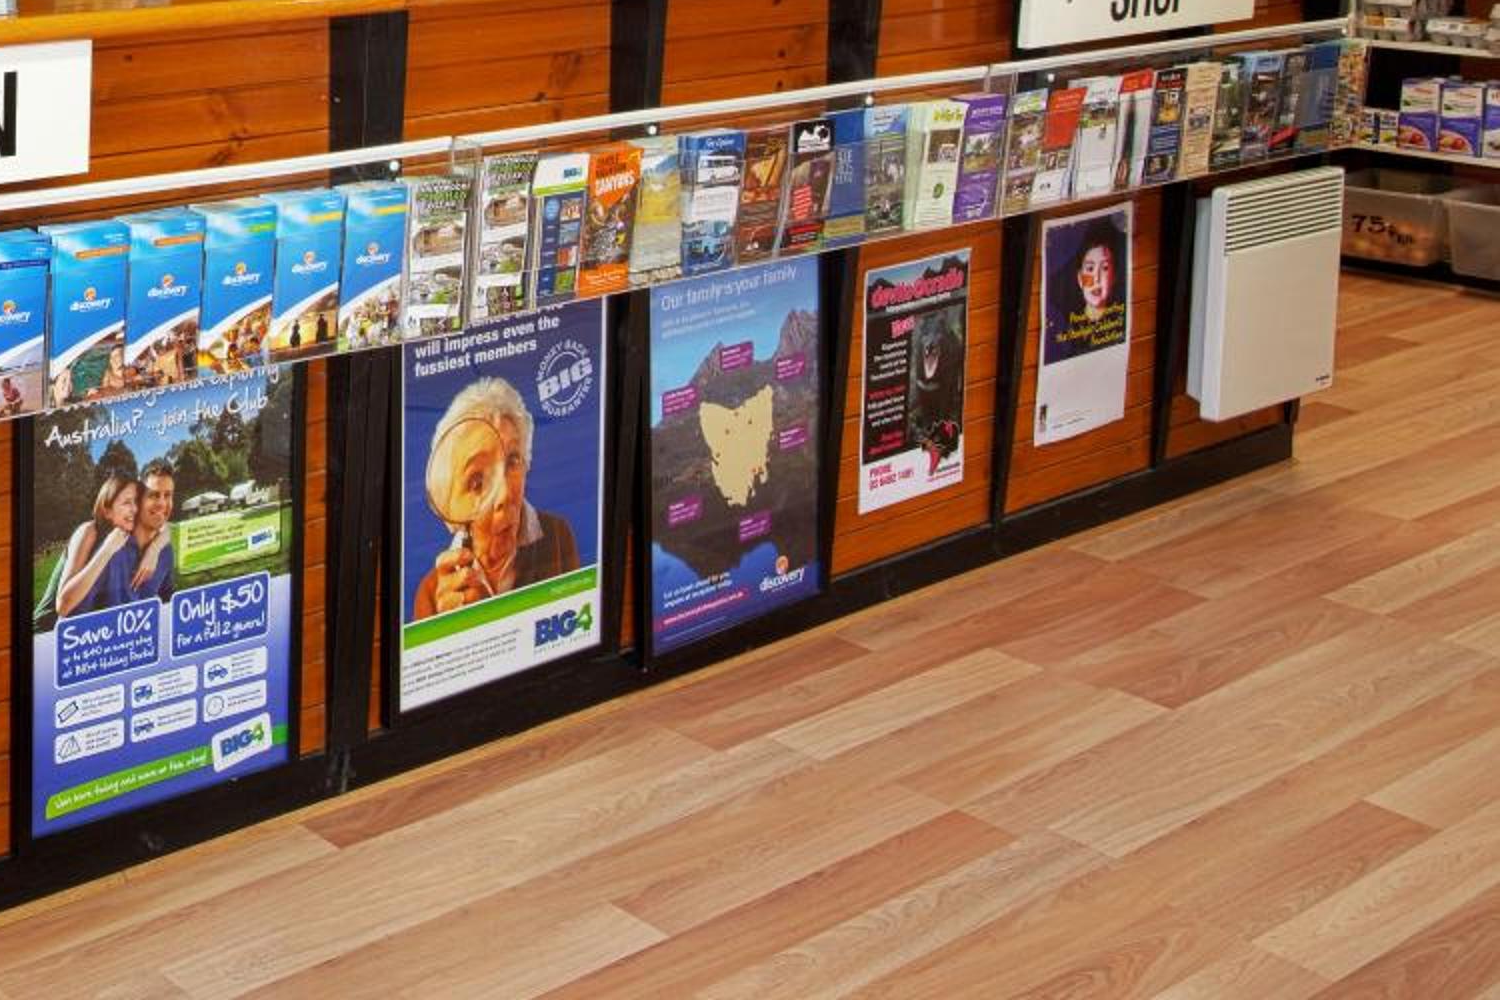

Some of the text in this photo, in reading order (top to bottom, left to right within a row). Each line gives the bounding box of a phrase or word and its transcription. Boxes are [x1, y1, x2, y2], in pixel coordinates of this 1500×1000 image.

[661, 295, 684, 311] Our
[763, 264, 797, 286] family
[415, 339, 441, 359] will
[444, 330, 499, 354] impress
[502, 323, 536, 339] even
[537, 315, 561, 331] the
[415, 338, 538, 378] fussiest members
[536, 357, 593, 402] BIG
[192, 399, 223, 422] the
[226, 387, 269, 414] Club
[44, 408, 144, 449] Australia?
[759, 566, 806, 592] discovery
[179, 579, 265, 625] Only $50
[62, 607, 154, 651] Save 10%
[176, 632, 192, 649] for
[204, 619, 221, 641] full
[222, 622, 232, 637] 2
[534, 602, 593, 647] BIG4
[220, 720, 265, 757] BIG4
